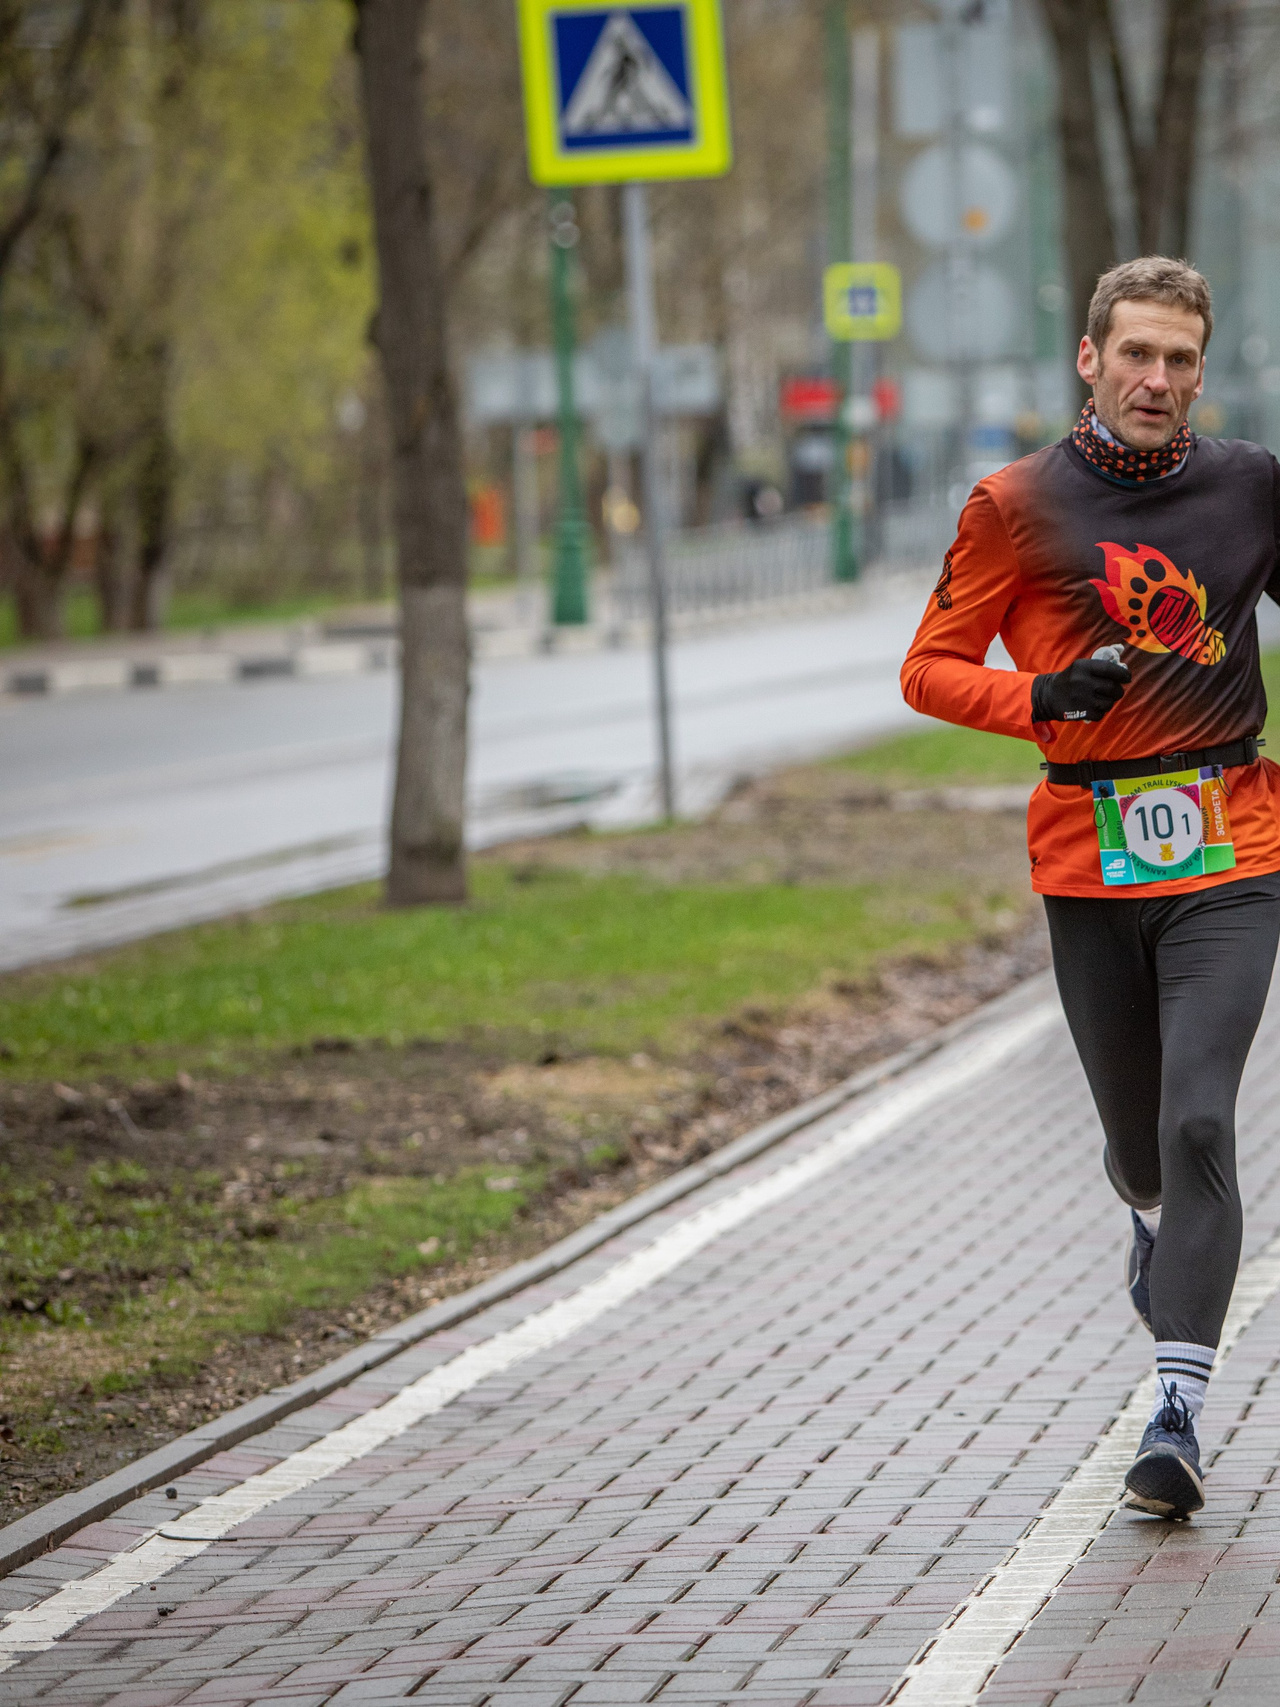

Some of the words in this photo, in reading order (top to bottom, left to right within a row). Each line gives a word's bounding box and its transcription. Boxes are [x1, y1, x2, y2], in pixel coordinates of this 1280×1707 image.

[1121, 786, 1142, 809] DREAM
[1142, 779, 1164, 790] TRAIL
[1166, 779, 1196, 797] LYSKOVO
[1211, 788, 1226, 837] ЭСТАФЕТА
[1116, 820, 1124, 840] TRAIL
[1136, 860, 1167, 876] KANNAS
[1179, 859, 1193, 872] ЛЕС
